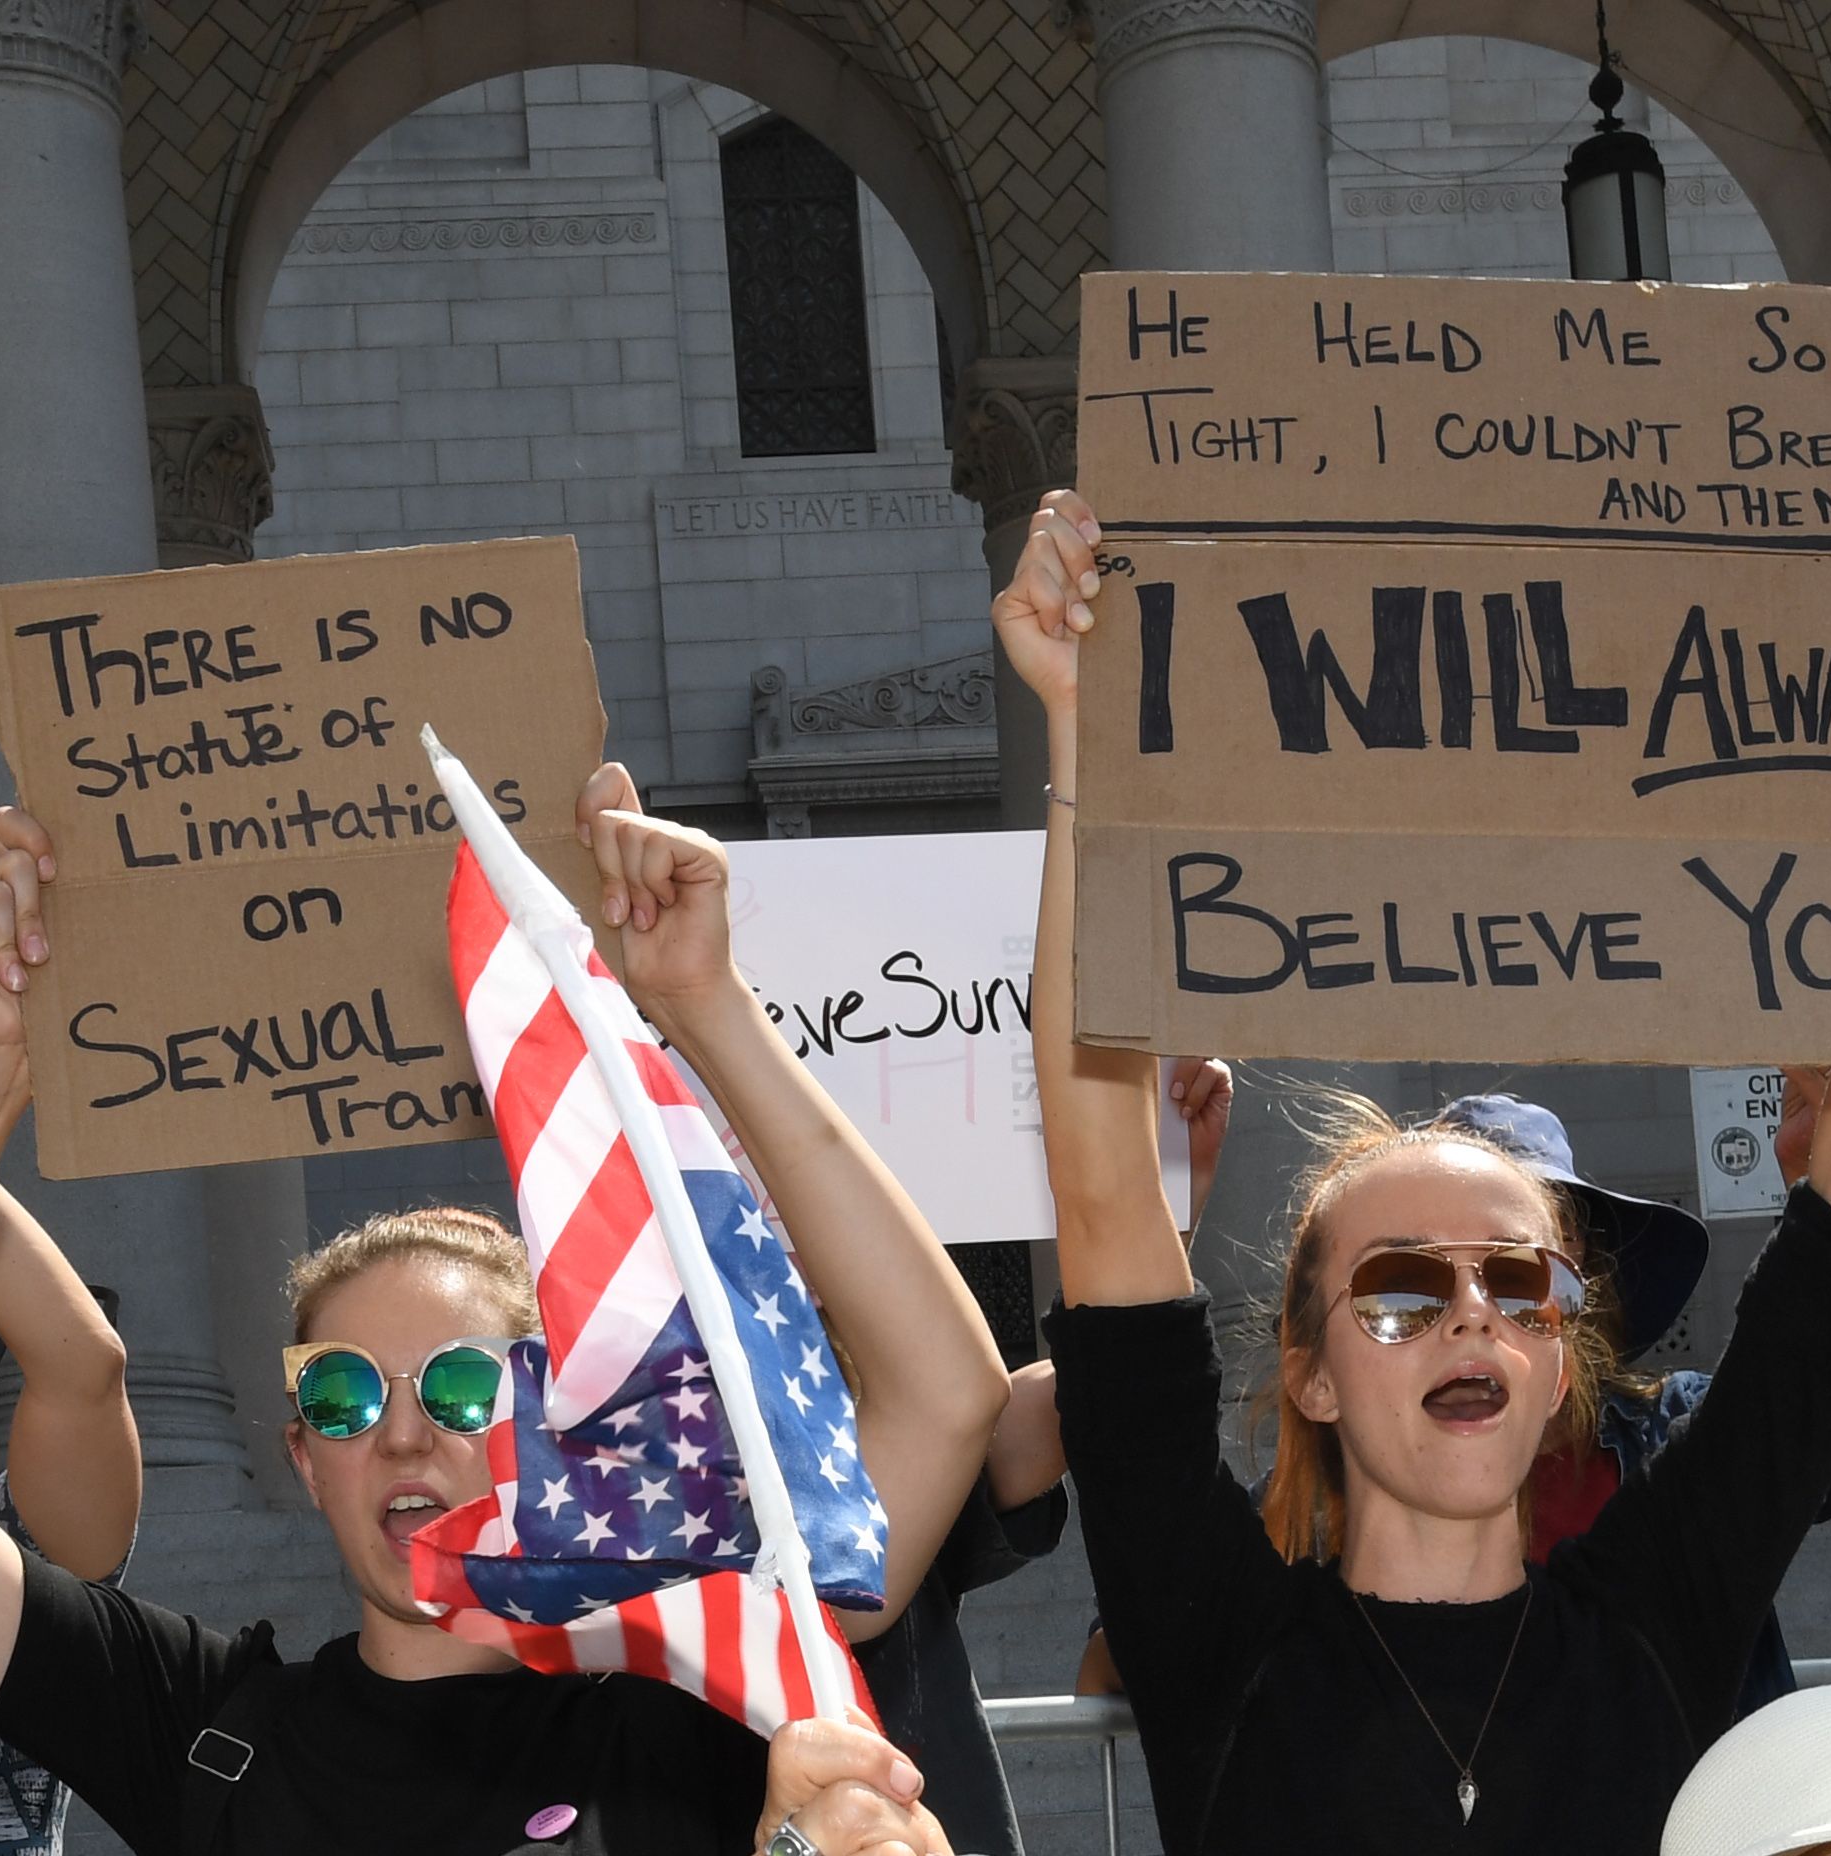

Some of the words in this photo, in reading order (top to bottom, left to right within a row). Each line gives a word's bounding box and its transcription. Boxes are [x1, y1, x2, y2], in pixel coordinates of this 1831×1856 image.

[1314, 302, 1482, 373] HELD
[1554, 307, 1662, 368] ME
[1373, 405, 1386, 464] I
[1434, 410, 1682, 467] COULDN'T
[732, 501, 770, 531] US
[778, 498, 857, 529] HAVE
[870, 494, 954, 524] FAITH
[1598, 479, 1686, 525] AND
[316, 609, 379, 662] IS
[419, 592, 512, 647] NO
[1134, 582, 1175, 753] I
[1236, 579, 1629, 755] WILL
[321, 697, 394, 748] of
[115, 779, 527, 870] Limitatios
[242, 886, 342, 941] on
[1167, 852, 1663, 994] BELIEVE
